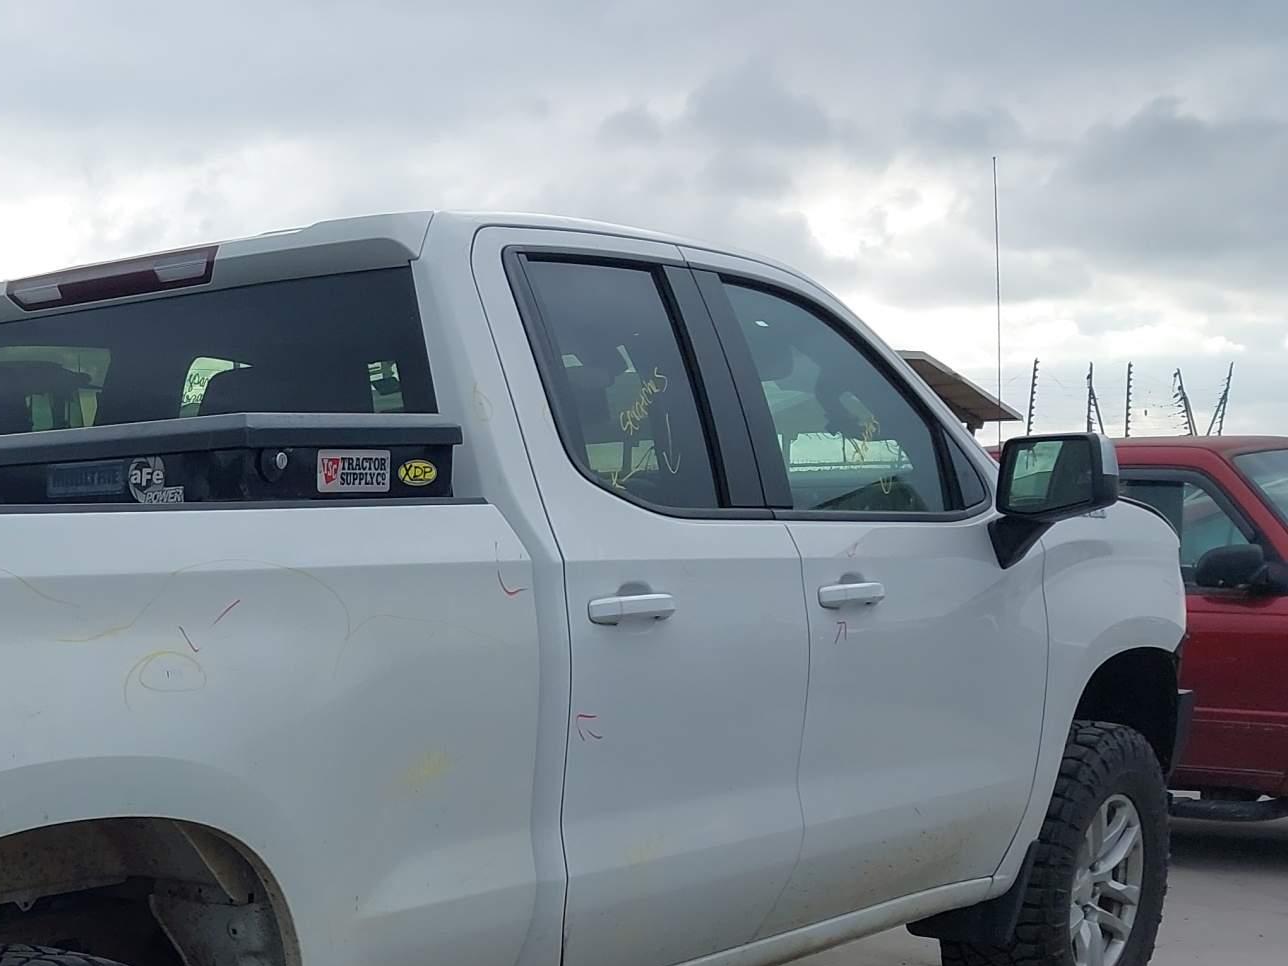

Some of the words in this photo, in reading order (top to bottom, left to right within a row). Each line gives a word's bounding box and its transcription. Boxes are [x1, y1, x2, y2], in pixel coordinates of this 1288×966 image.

[340, 457, 387, 471] TRACTOR
[131, 468, 164, 486] aFe
[340, 472, 376, 486] SUPPLY
[402, 463, 433, 481] XDP
[145, 489, 184, 503] POWER
